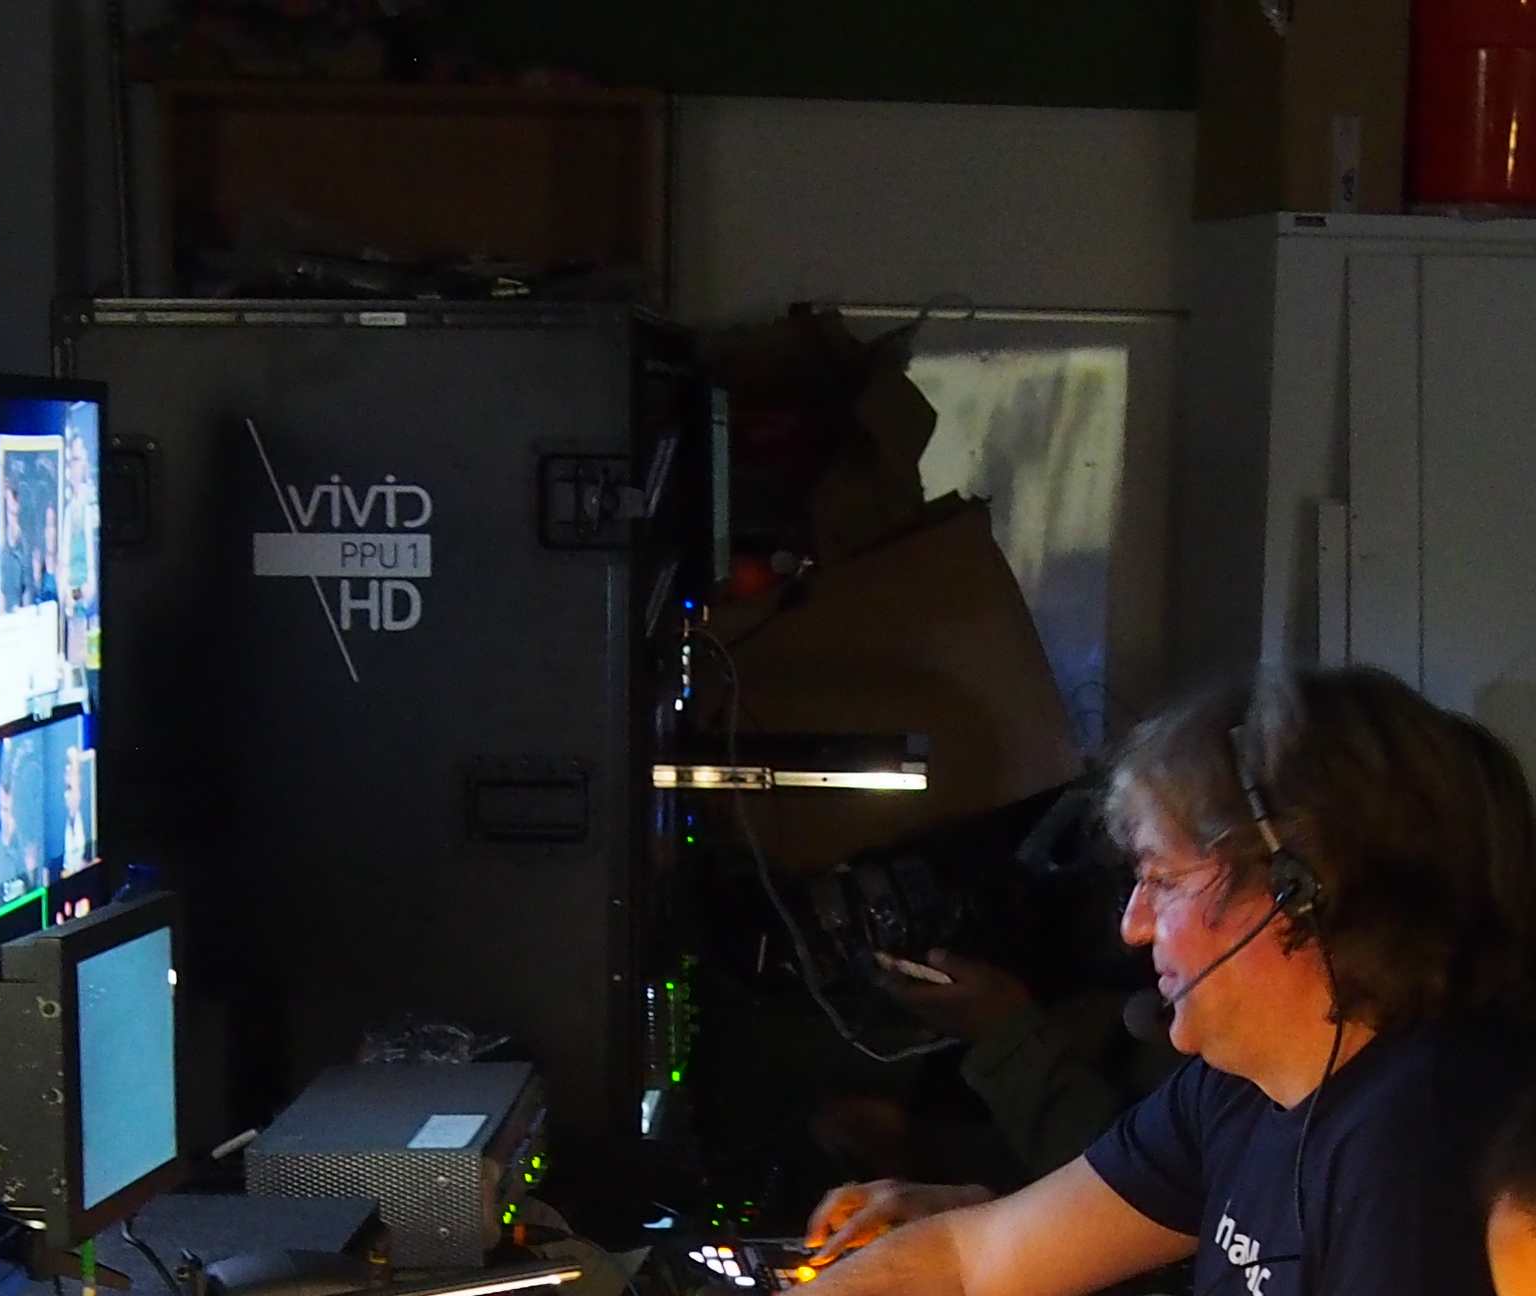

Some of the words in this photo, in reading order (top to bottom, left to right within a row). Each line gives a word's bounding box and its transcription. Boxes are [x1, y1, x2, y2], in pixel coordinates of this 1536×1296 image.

[340, 541, 399, 570] PPU
[408, 542, 419, 570] 1
[339, 578, 422, 632] HD
